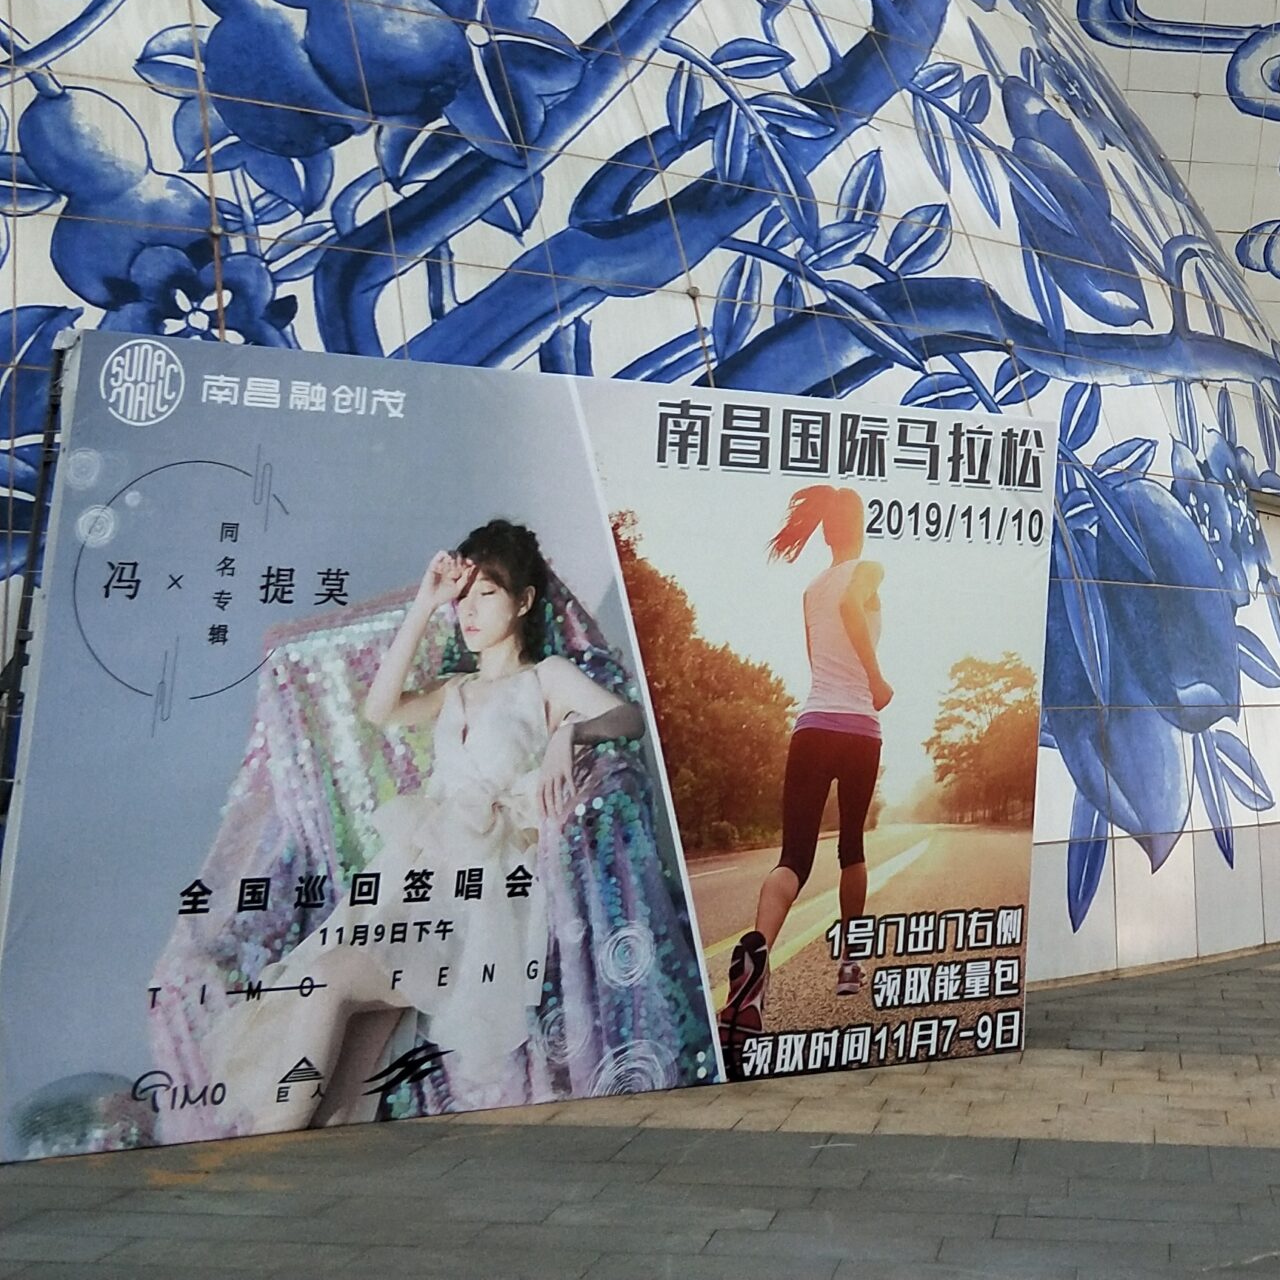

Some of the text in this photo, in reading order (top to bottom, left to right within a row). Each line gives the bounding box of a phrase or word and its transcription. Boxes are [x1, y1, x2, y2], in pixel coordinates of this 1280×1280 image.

[110, 343, 179, 400] SUNAC
[201, 373, 406, 419] 南昌融创茂
[108, 379, 168, 421] MALL
[656, 399, 1045, 490] 南昌国际马拉松
[865, 499, 1044, 545] 2019/11/10
[207, 522, 240, 646] 同名专辑
[178, 865, 535, 914] 全国巡回签唱会
[319, 919, 454, 947] 11月9日下午
[827, 907, 1024, 959] 1号门出门右侧
[147, 960, 540, 1009] TIMO FENG
[873, 960, 1020, 1008] 领取能量包
[742, 1011, 1021, 1077] 领取时间11月7-9日
